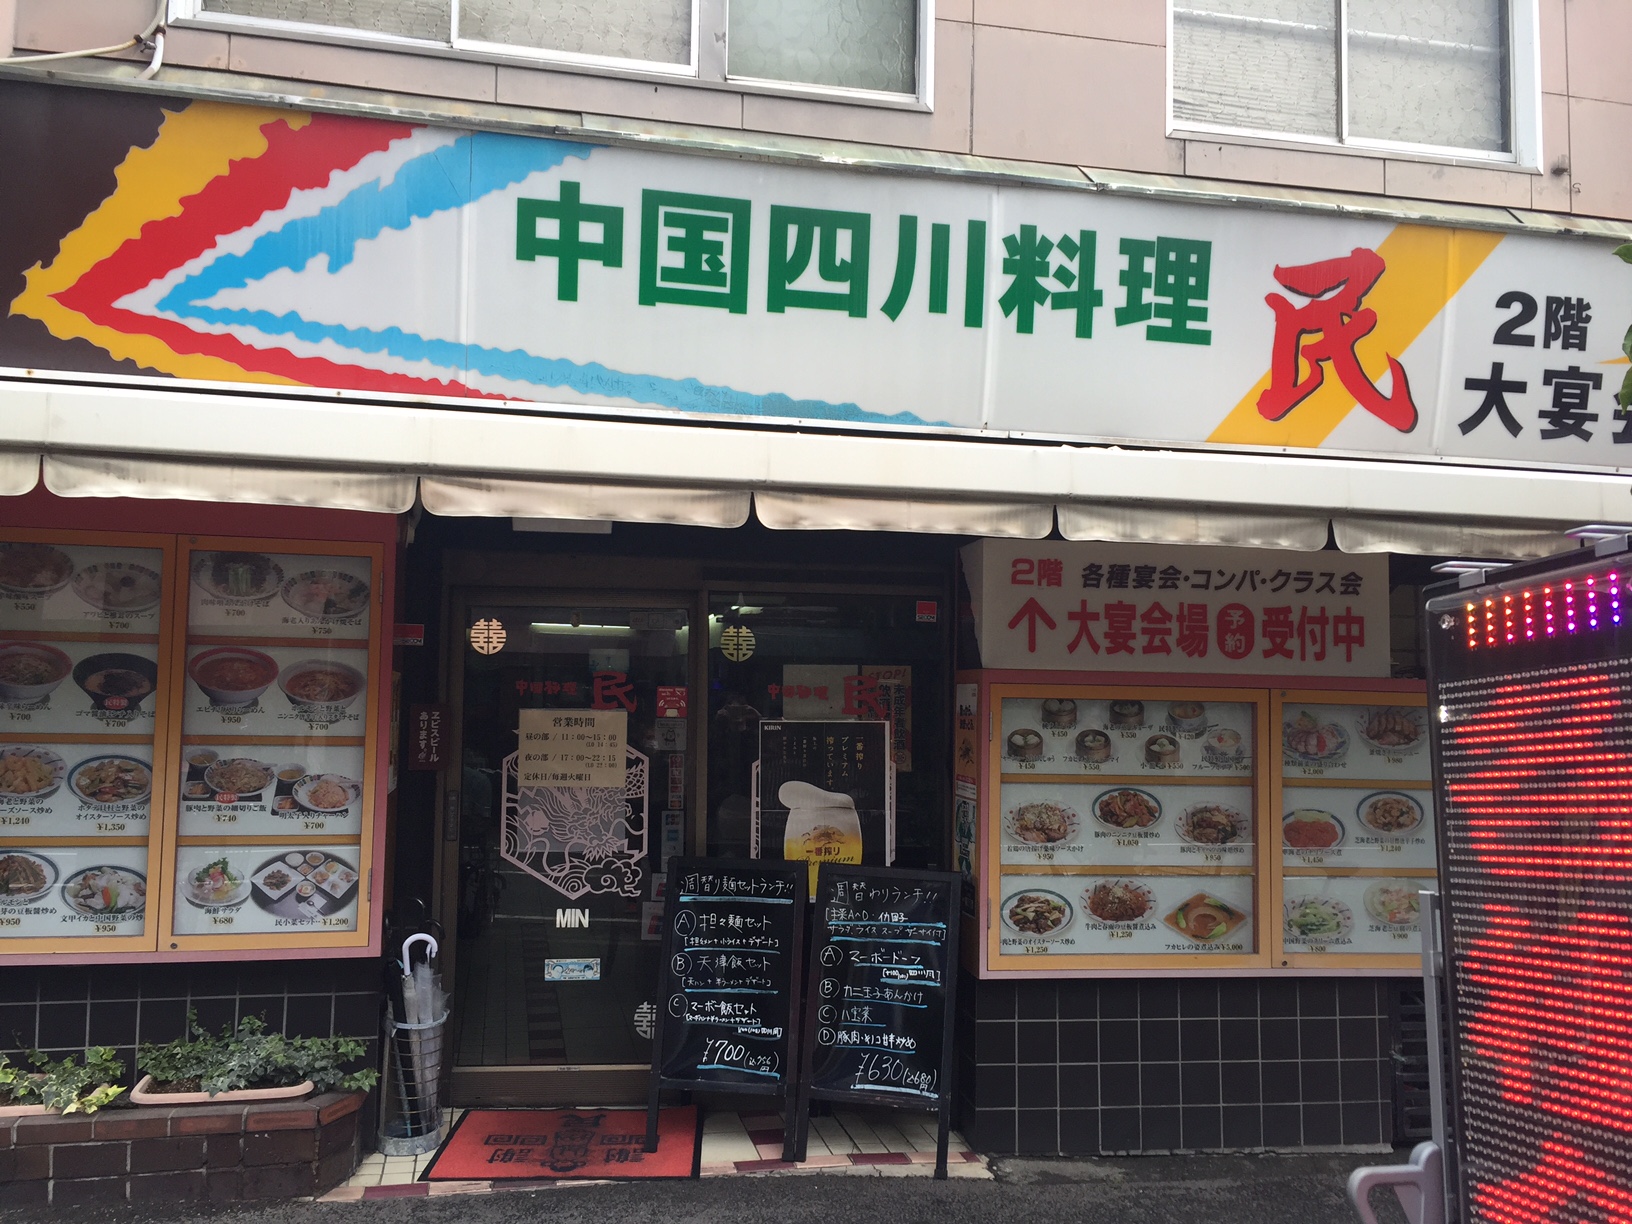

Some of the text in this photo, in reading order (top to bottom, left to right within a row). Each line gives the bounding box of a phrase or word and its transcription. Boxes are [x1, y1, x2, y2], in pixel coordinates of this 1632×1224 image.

[516, 180, 1212, 345] 中国四川料理
[1493, 291, 1592, 351] 2階
[1256, 247, 1418, 433] 民
[1011, 558, 1363, 596] 2階 各種宴会・コンパ・クラス会
[224, 608, 246, 616] ¥700
[1067, 599, 1365, 662] 大宴会場 予約 受付中
[591, 670, 637, 713] 民
[842, 676, 888, 718] 民
[105, 720, 126, 728] ¥700
[221, 716, 242, 724] ¥950
[552, 717, 596, 728] 営業時間
[525, 732, 550, 741] 昼の部
[524, 753, 549, 762] 夜の部
[841, 736, 850, 777] プレミアム
[855, 736, 864, 770] 一番搾り
[524, 772, 591, 782] 定休日/毎週火曜日
[0, 816, 30, 824] ¥1,240
[76, 813, 146, 821] オイスターソース炒め
[215, 814, 237, 822] ¥740
[96, 823, 126, 831] ¥1,350
[806, 846, 840, 856] 一番搾り
[204, 906, 242, 914] 海鮮サラダ
[556, 908, 589, 928] MIN
[212, 916, 233, 925] ¥680
[322, 918, 349, 926] ¥1,200
[699, 912, 772, 934] 担々麺セット
[95, 925, 116, 933] ¥950
[697, 954, 771, 974] 天津飯セット
[844, 985, 923, 1002] カニ玉子あんかけ
[690, 1000, 757, 1016] マーボー飯セット
[842, 1004, 873, 1023] 八宝菜
[702, 1038, 745, 1064] ¥700
[854, 1052, 904, 1084] ¥630
